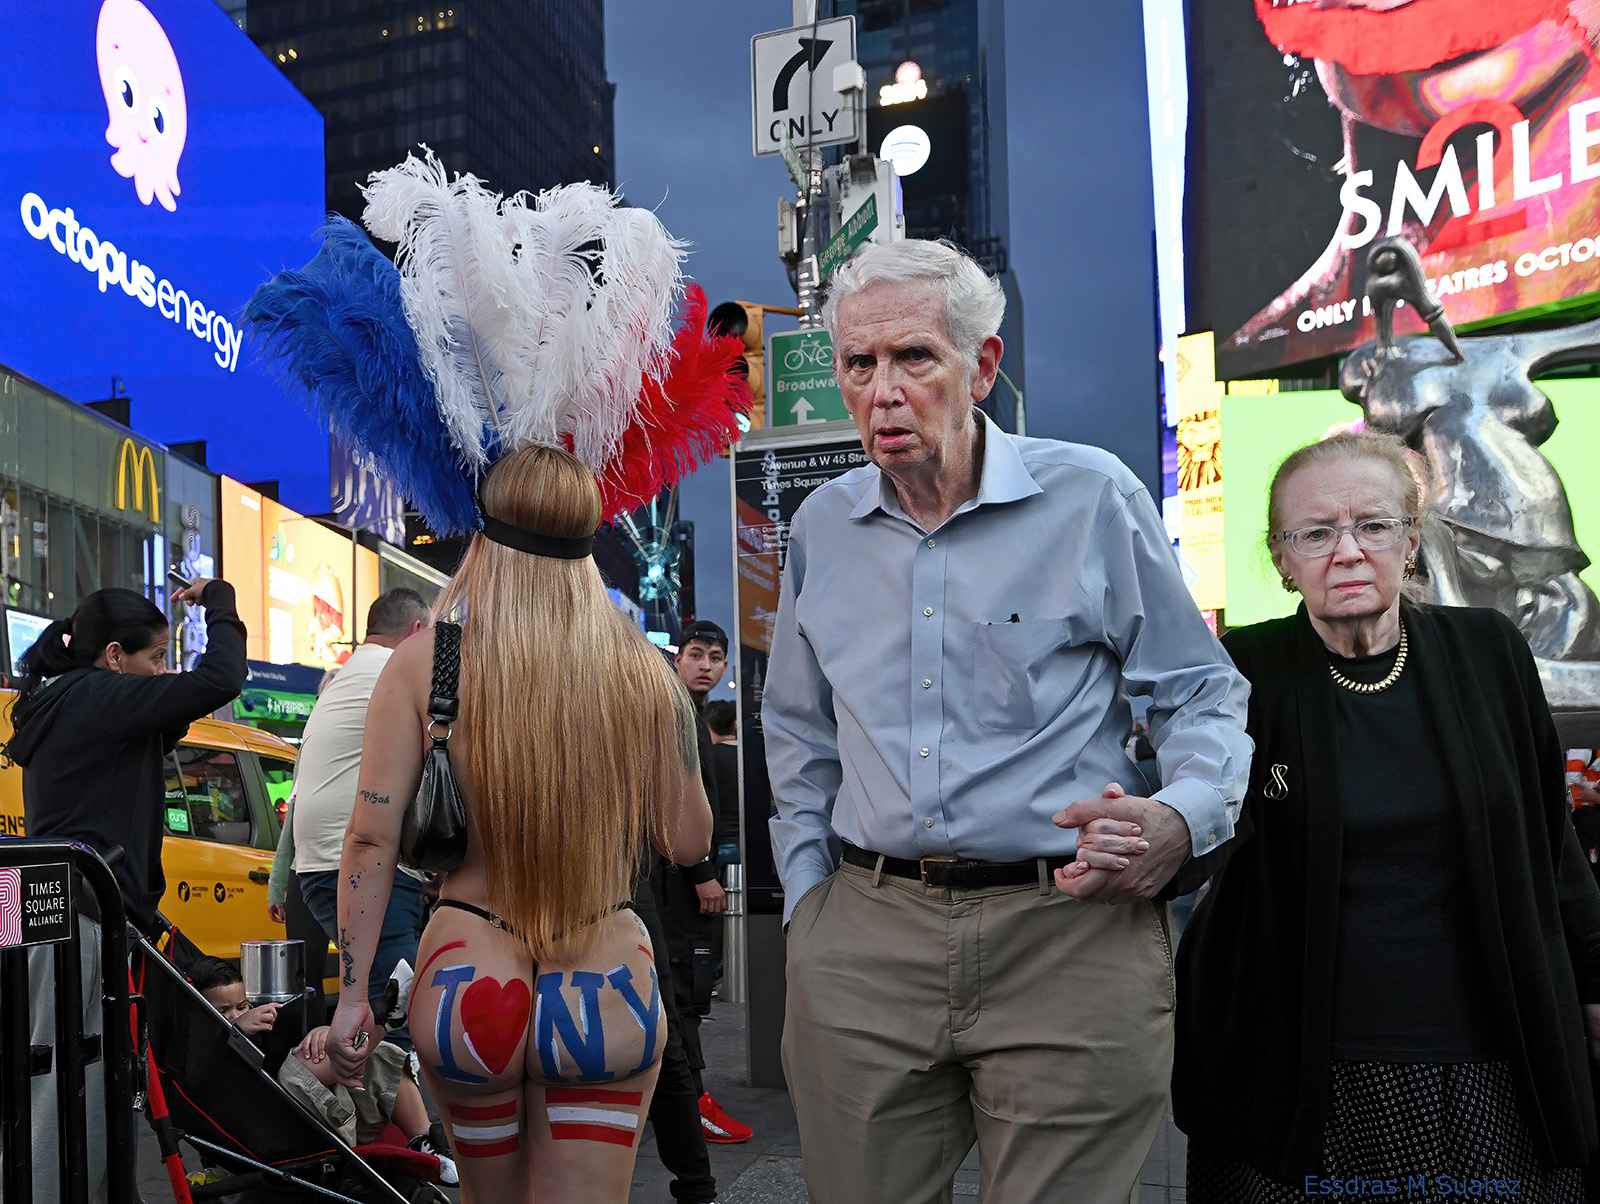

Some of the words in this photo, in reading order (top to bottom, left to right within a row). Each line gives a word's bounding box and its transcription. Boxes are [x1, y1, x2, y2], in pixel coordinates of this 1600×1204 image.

[770, 109, 839, 142] ONLY
[1339, 97, 1600, 249] SMILE
[1415, 100, 1527, 258] 2
[1297, 298, 1357, 332] ONLY
[1514, 235, 1600, 277] OCTO
[777, 377, 840, 392] Broadwa
[769, 460, 807, 472] Avenue
[819, 455, 831, 466] W
[832, 454, 846, 465] 45
[848, 452, 870, 463] Stre
[793, 476, 831, 489] Squar
[29, 881, 62, 896] TIMES
[25, 896, 65, 915] SQUARE
[28, 913, 63, 927] ALLIANCE
